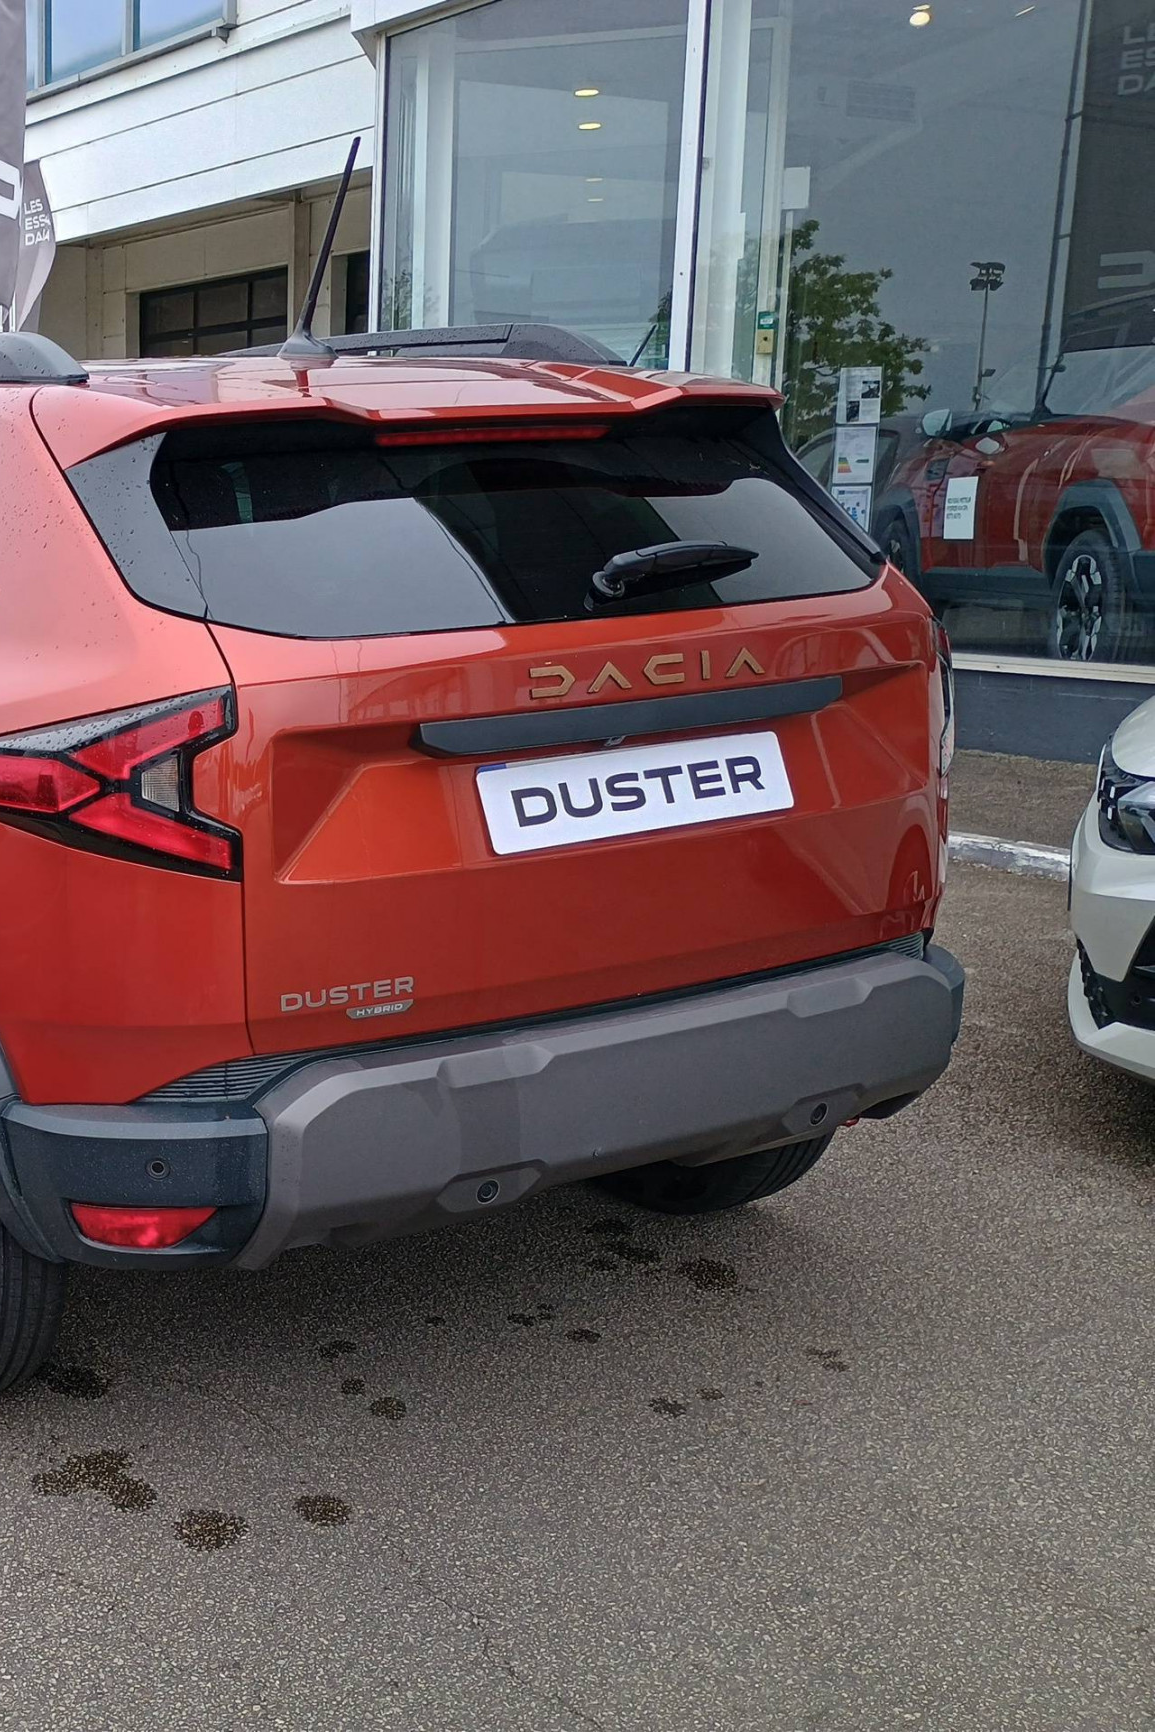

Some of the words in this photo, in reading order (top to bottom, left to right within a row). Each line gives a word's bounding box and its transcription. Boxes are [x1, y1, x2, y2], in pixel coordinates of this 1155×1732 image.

[24, 199, 43, 214] LES
[530, 648, 766, 699] DACIA
[510, 755, 766, 828] DUSTER
[280, 976, 414, 1012] DUSTER
[356, 1003, 403, 1016] HYBRID
